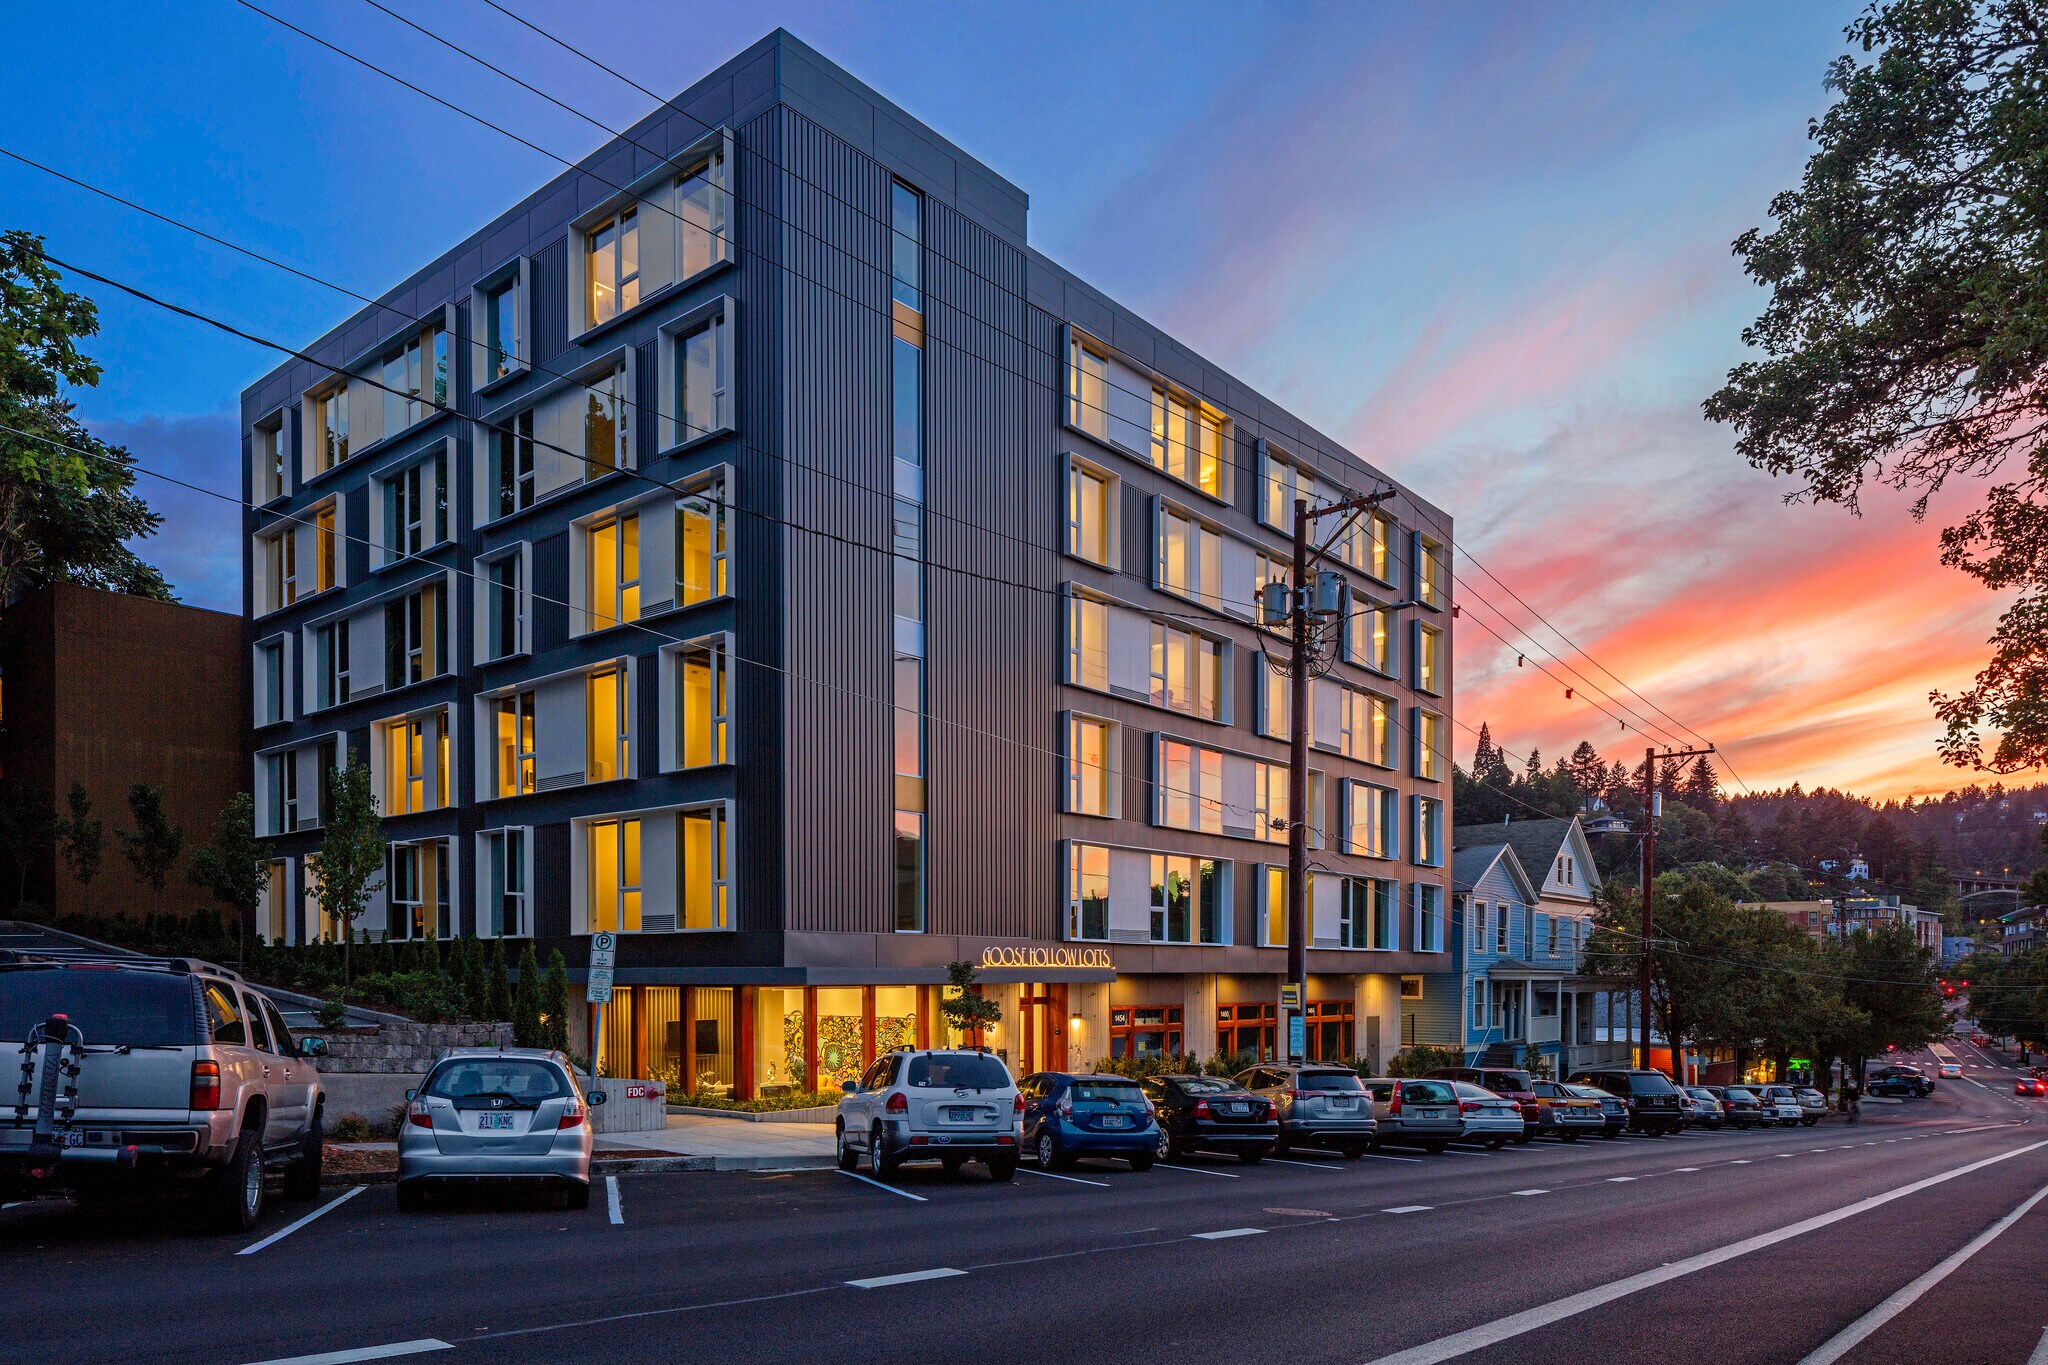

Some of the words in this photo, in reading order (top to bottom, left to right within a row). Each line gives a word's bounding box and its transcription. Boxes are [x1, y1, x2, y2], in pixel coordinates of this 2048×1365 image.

[600, 937, 609, 947] P
[982, 946, 1026, 966] GOOSE
[1029, 947, 1077, 967] HOLLOW
[1079, 948, 1111, 967] LOFTS
[1114, 1014, 1126, 1022] 1454
[39, 1053, 59, 1118] YAKIMA
[627, 1087, 645, 1097] FDC
[480, 1115, 493, 1126] 211
